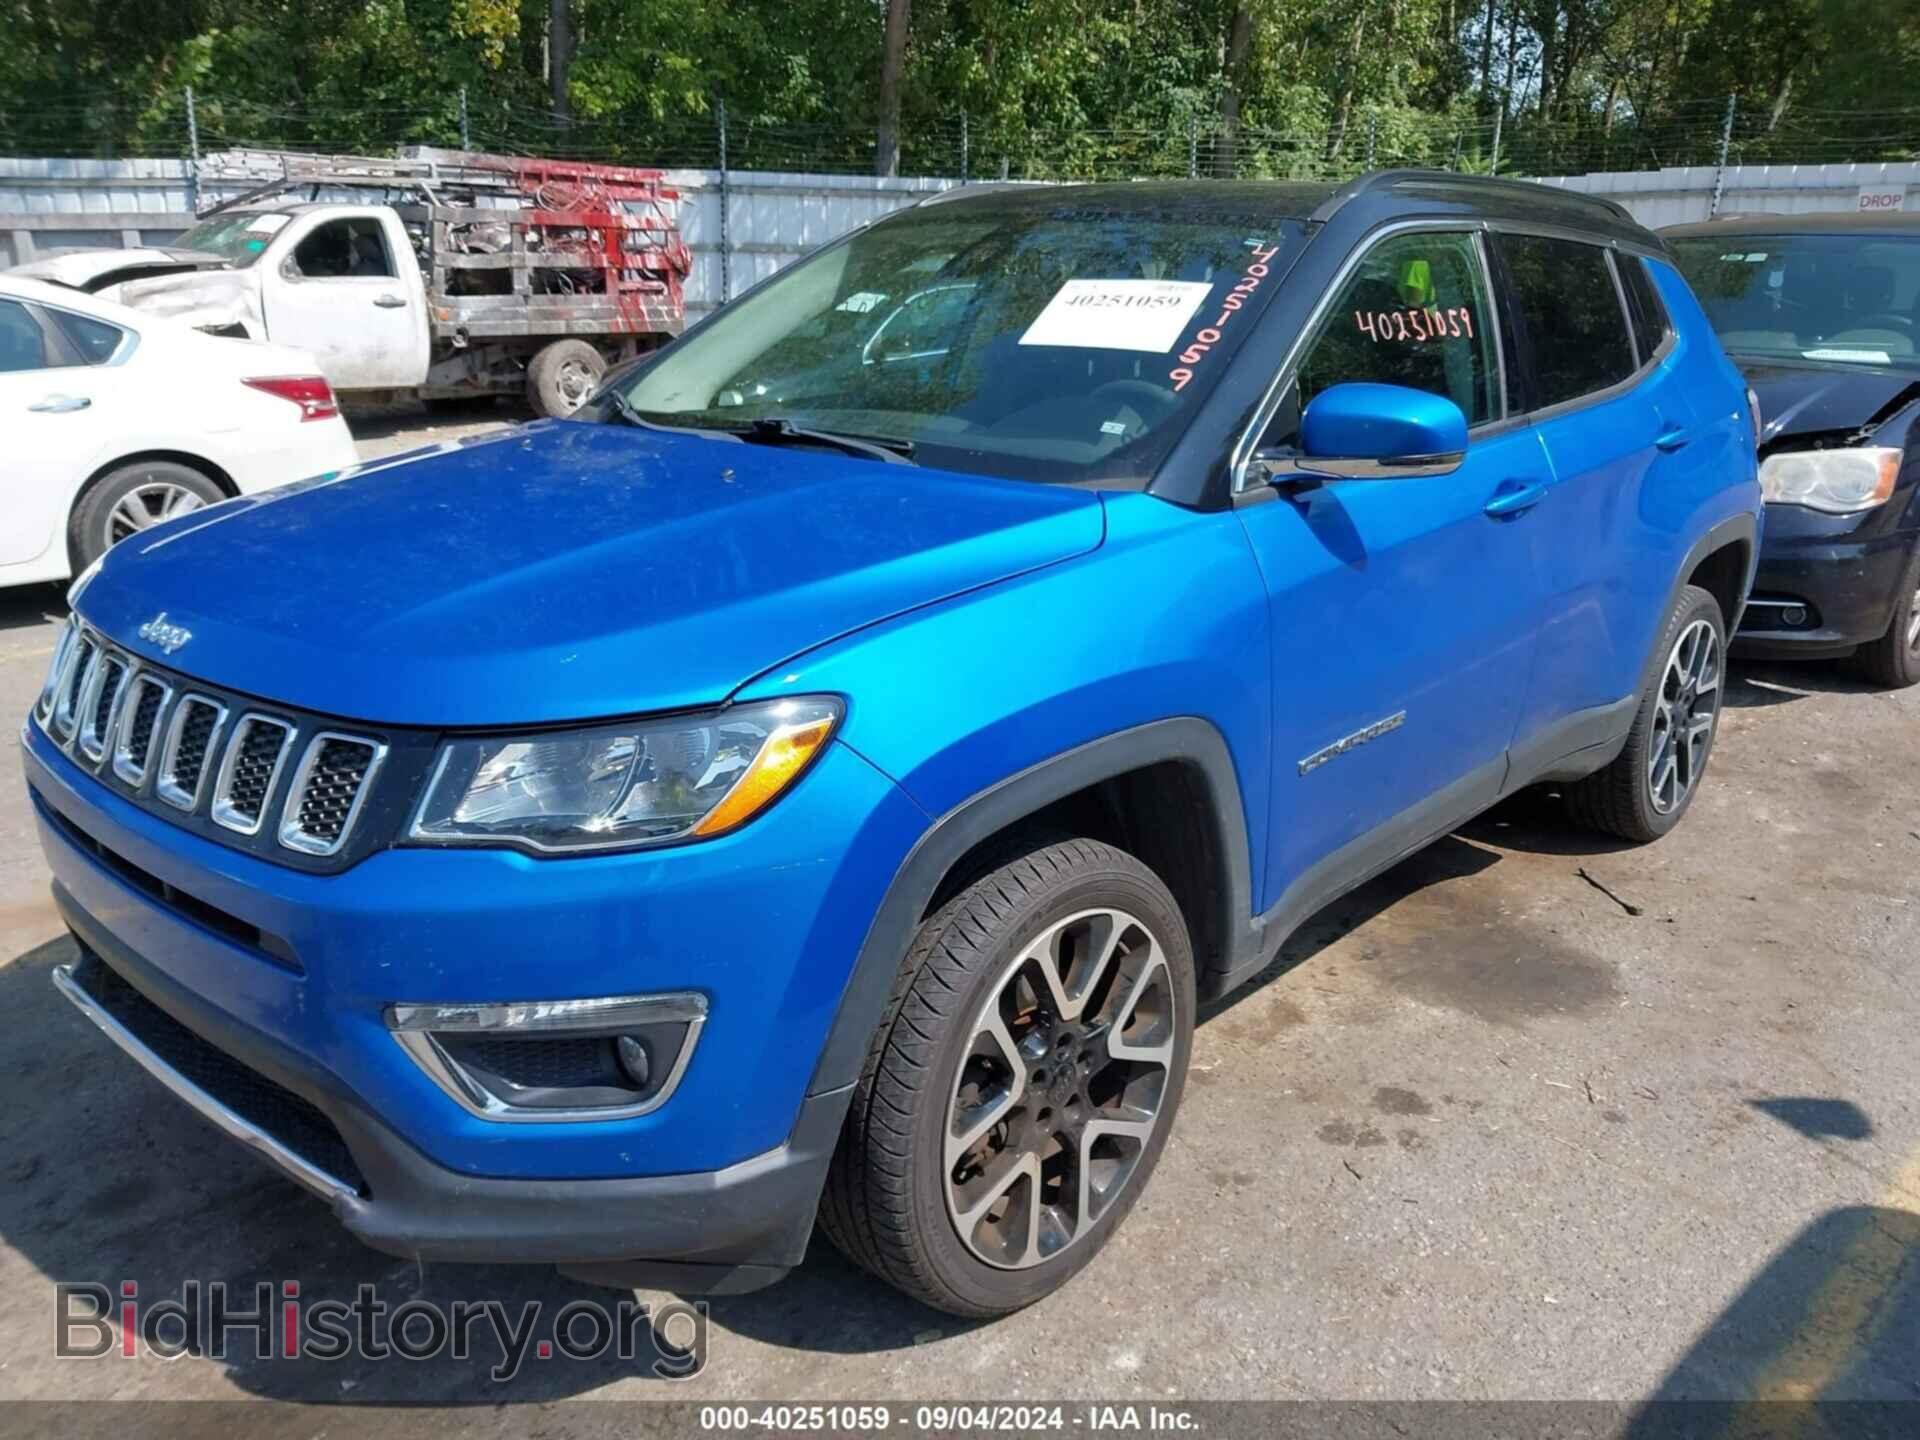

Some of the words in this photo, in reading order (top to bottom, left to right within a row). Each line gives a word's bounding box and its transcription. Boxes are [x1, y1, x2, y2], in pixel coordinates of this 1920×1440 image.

[1859, 193, 1902, 208] DROP
[1065, 294, 1182, 309] 40251059
[1169, 243, 1279, 391] 40251059
[1355, 307, 1473, 342] 40251059
